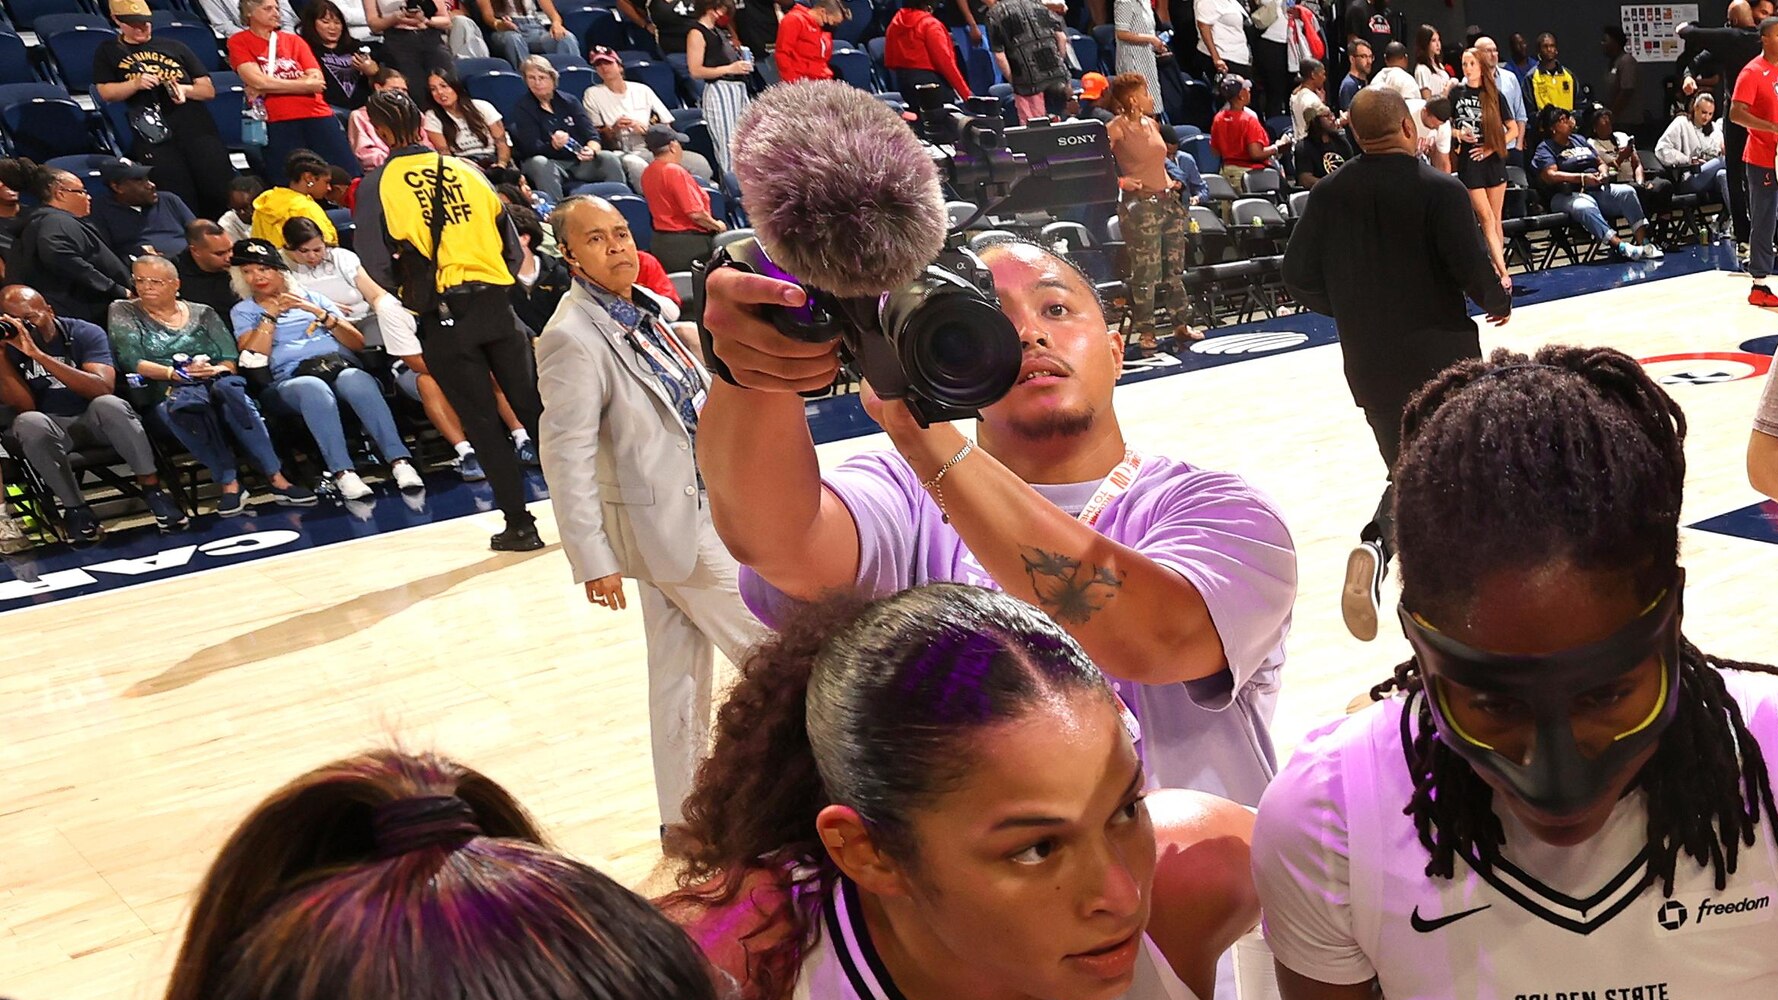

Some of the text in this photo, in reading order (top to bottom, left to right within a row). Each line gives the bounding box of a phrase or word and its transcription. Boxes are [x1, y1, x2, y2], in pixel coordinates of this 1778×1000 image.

[1057, 134, 1097, 146] SONY
[403, 166, 457, 188] CSC
[413, 183, 466, 208] EVNT
[422, 204, 472, 227] SAFF
[1094, 491, 1108, 503] TO
[1696, 895, 1769, 924] freedom
